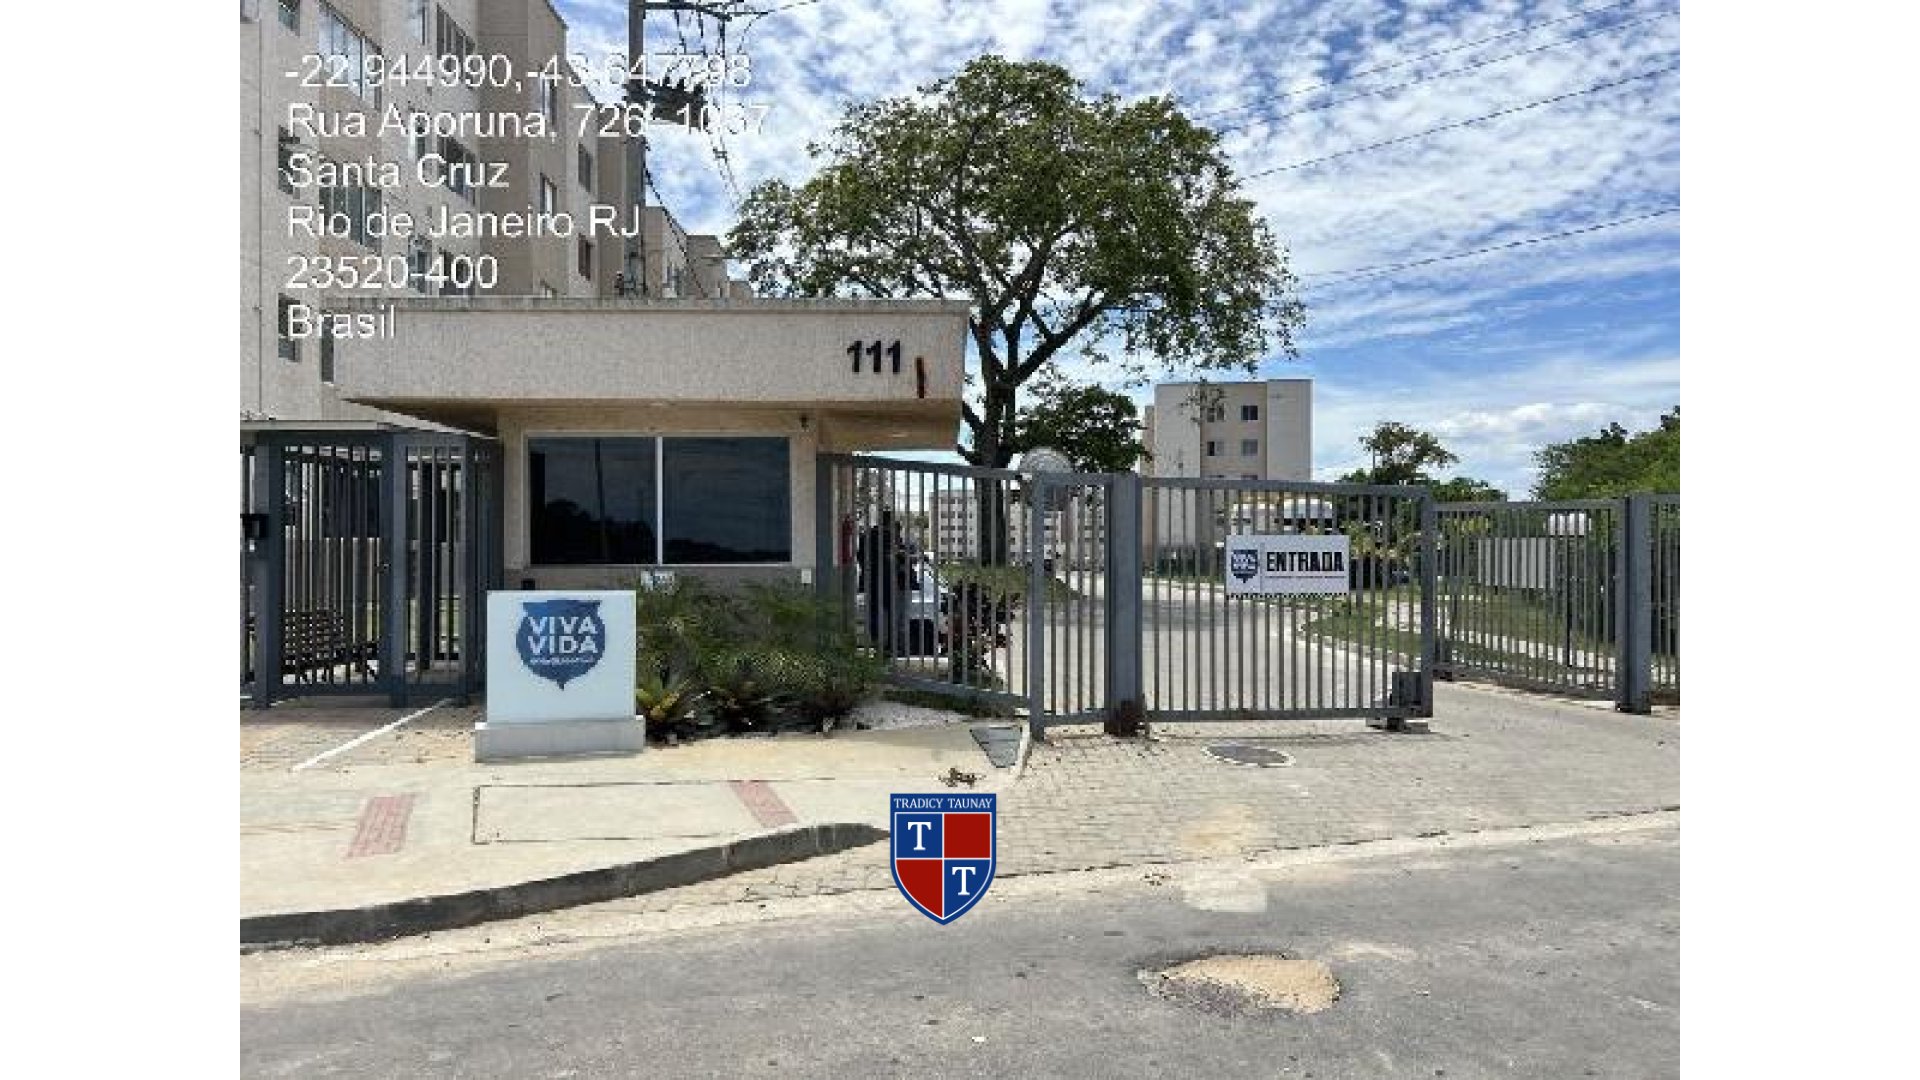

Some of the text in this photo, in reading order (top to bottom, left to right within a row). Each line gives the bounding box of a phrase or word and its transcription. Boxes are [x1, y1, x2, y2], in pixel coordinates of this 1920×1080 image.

[846, 339, 902, 375] 111
[1266, 551, 1345, 572] ENTRADA
[527, 616, 599, 635] VIVA
[527, 635, 599, 655] VIDA
